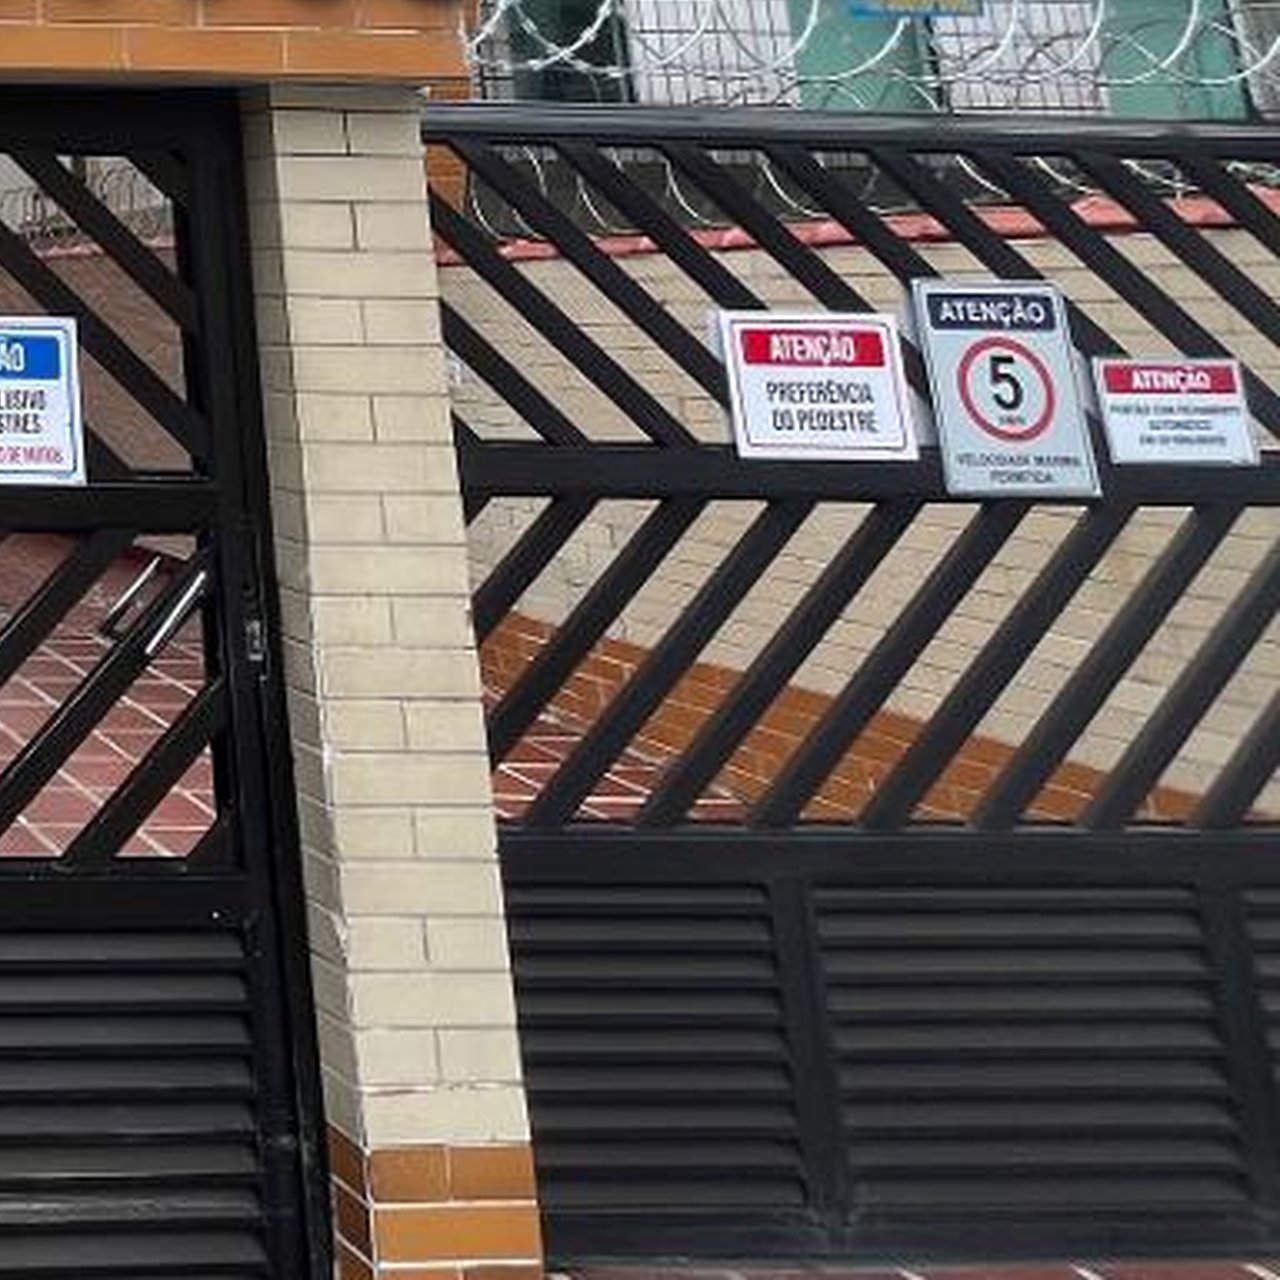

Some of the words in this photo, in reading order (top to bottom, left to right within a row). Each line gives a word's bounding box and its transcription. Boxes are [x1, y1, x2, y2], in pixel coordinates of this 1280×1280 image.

[940, 297, 1045, 328] ATENÇÃO
[770, 331, 855, 365] ATENÇÃO
[766, 380, 874, 404] PREFERÊNCIA
[991, 356, 1023, 410] 5
[1132, 367, 1211, 392] ATENÇÃO
[773, 410, 795, 430] DO
[798, 410, 878, 432] PEDESTRE
